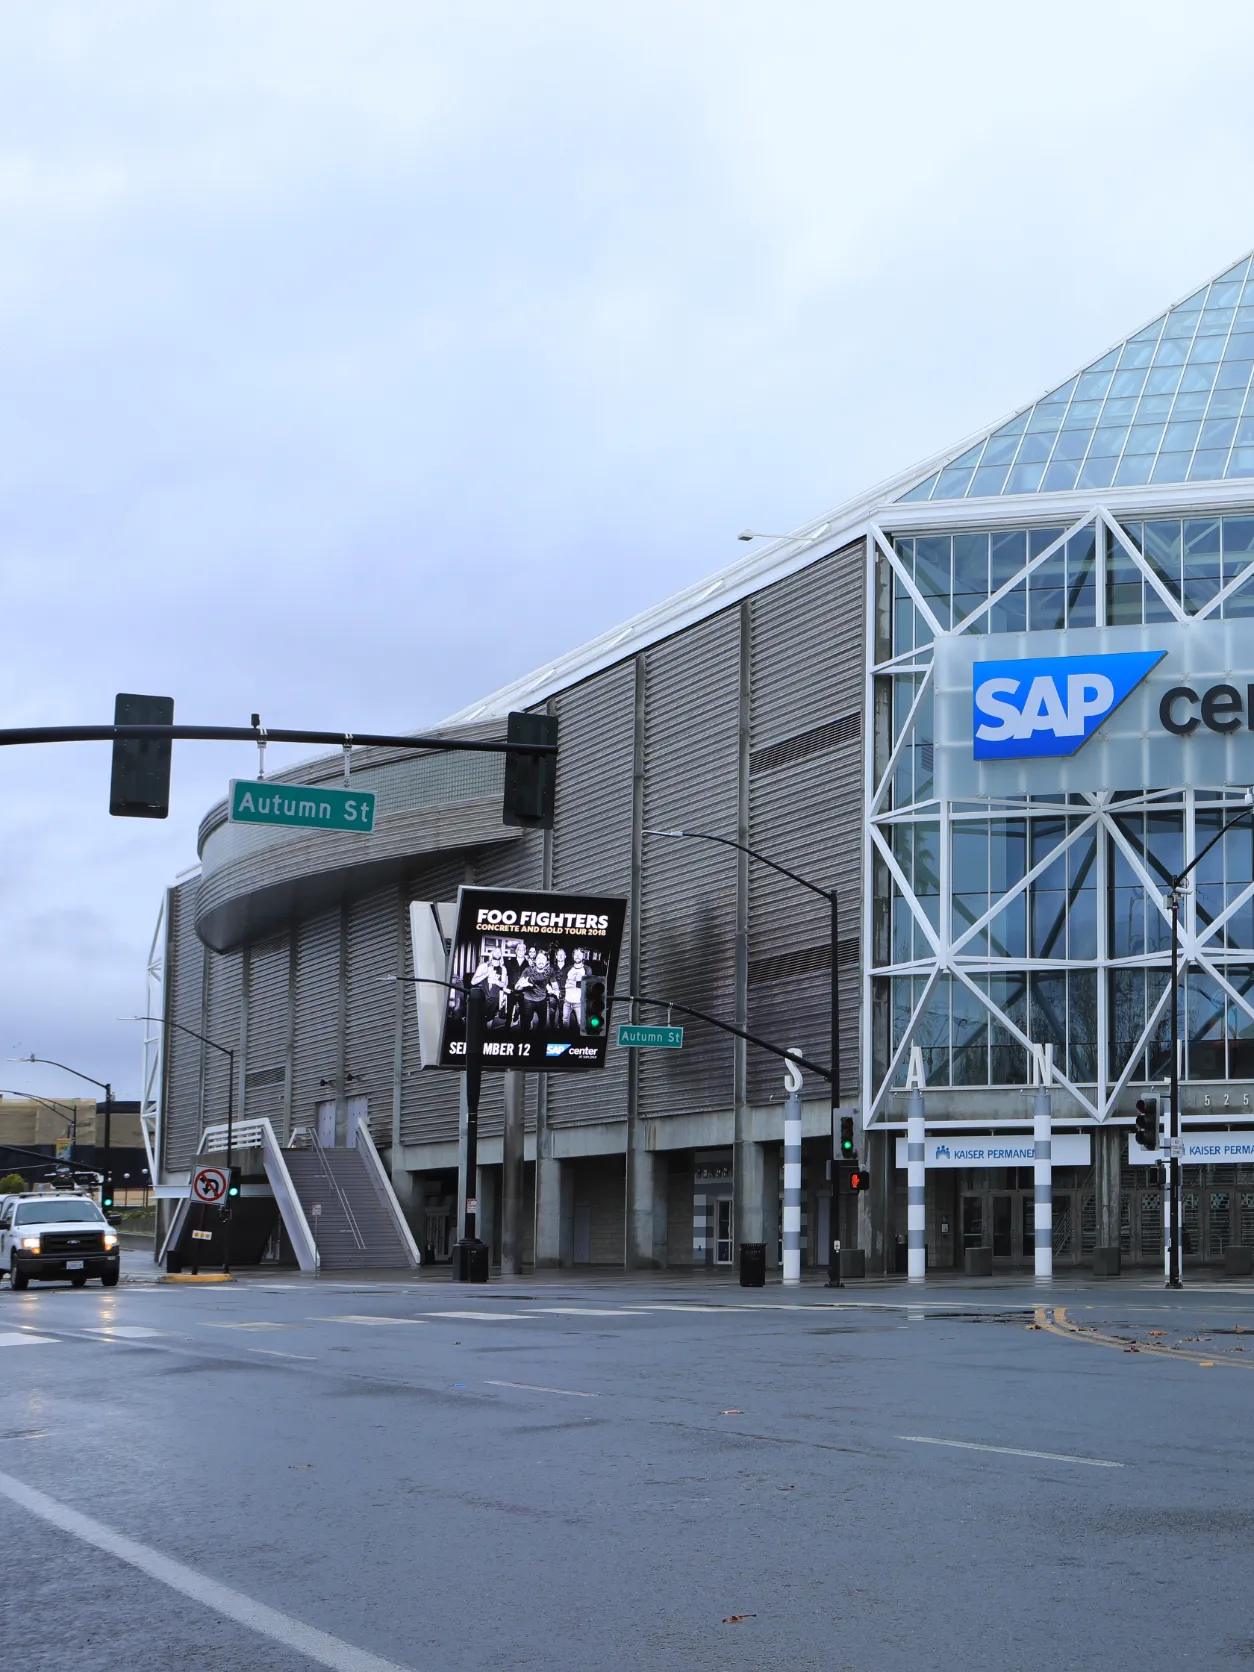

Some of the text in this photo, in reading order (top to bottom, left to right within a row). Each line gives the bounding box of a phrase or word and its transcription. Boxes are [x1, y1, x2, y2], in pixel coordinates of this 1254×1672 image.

[974, 673, 1115, 742] SAP
[238, 791, 370, 823] Autumn St
[477, 909, 609, 929] FOO FIGHTERS
[476, 924, 607, 936] CONCRETE AND GOLD TOUR 2018
[621, 1031, 680, 1043] Autumn St
[448, 1041, 531, 1056] SEMBER 12
[546, 1045, 599, 1056] SAP center
[954, 1148, 1035, 1159] KAISER PERMANE
[1189, 1145, 1221, 1156] KAISER
